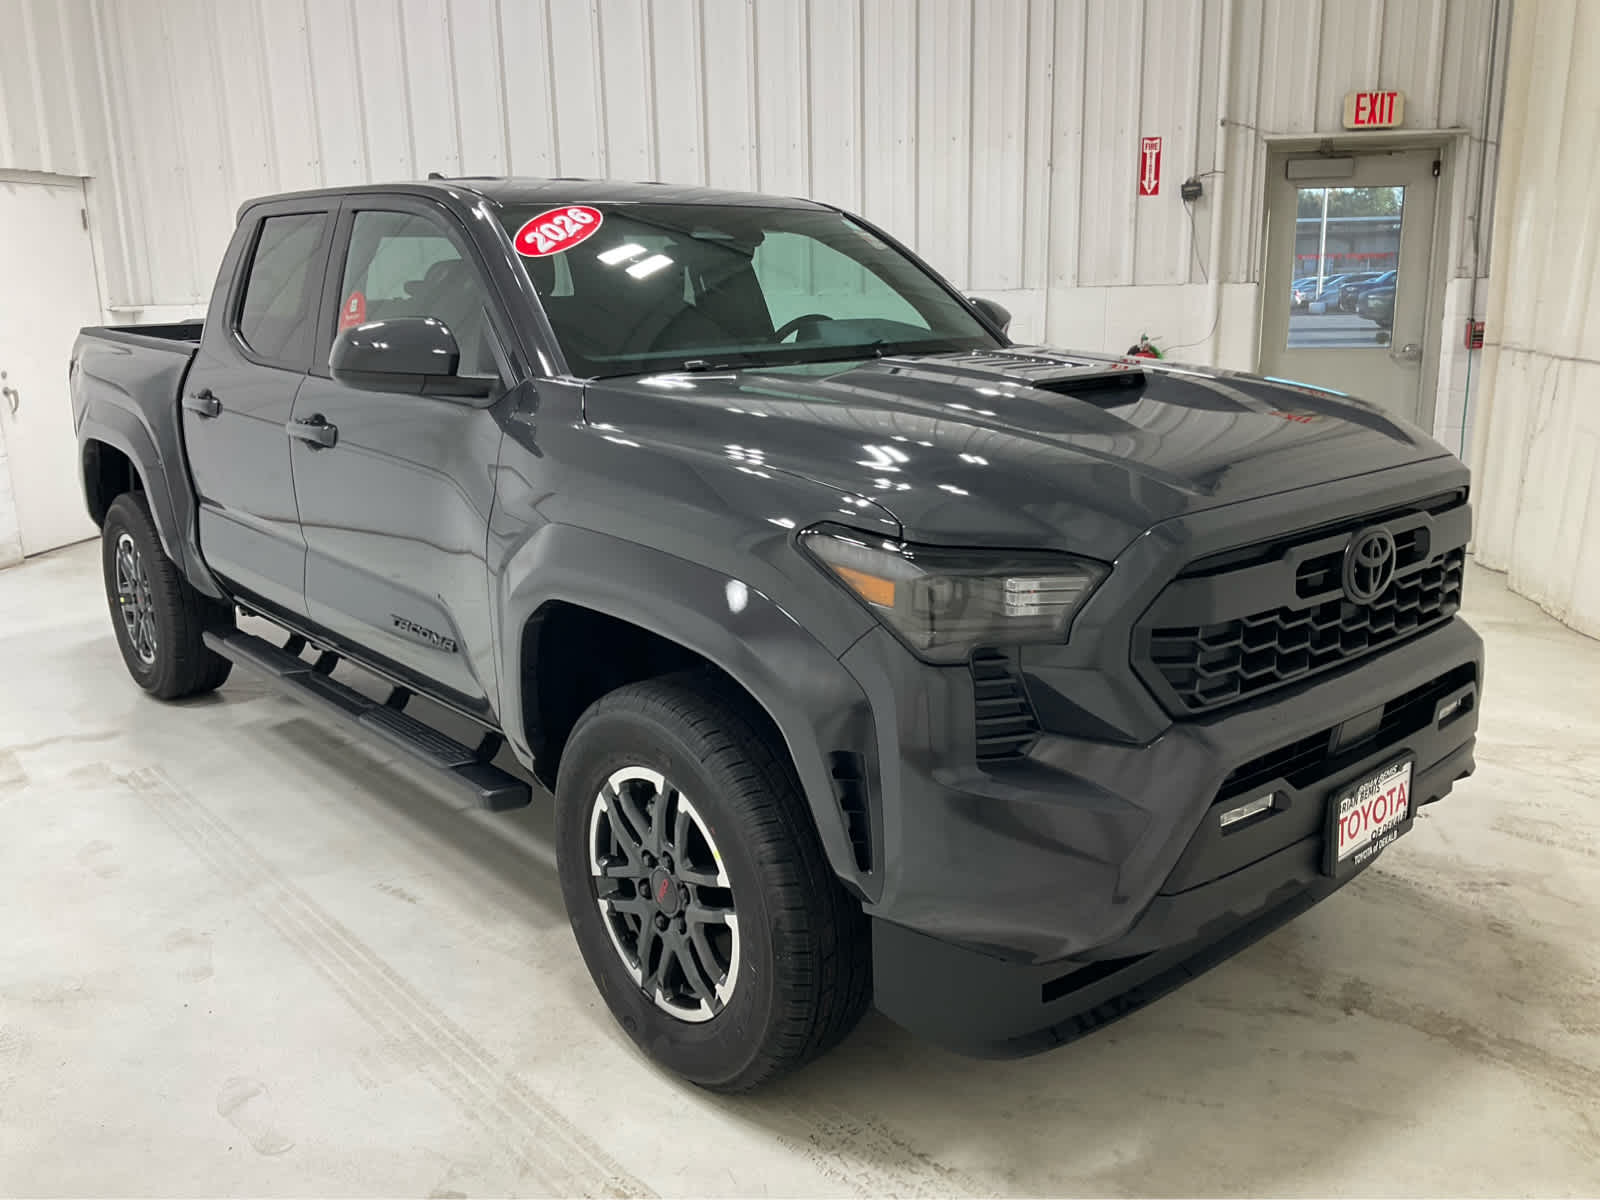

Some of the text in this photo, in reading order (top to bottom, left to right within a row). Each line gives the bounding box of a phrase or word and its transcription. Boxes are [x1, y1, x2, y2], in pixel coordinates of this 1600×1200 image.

[1354, 92, 1398, 125] EXIT
[524, 208, 594, 253] 2026
[1339, 797, 1358, 813] RIAN
[1339, 783, 1406, 847] TOYOTA
